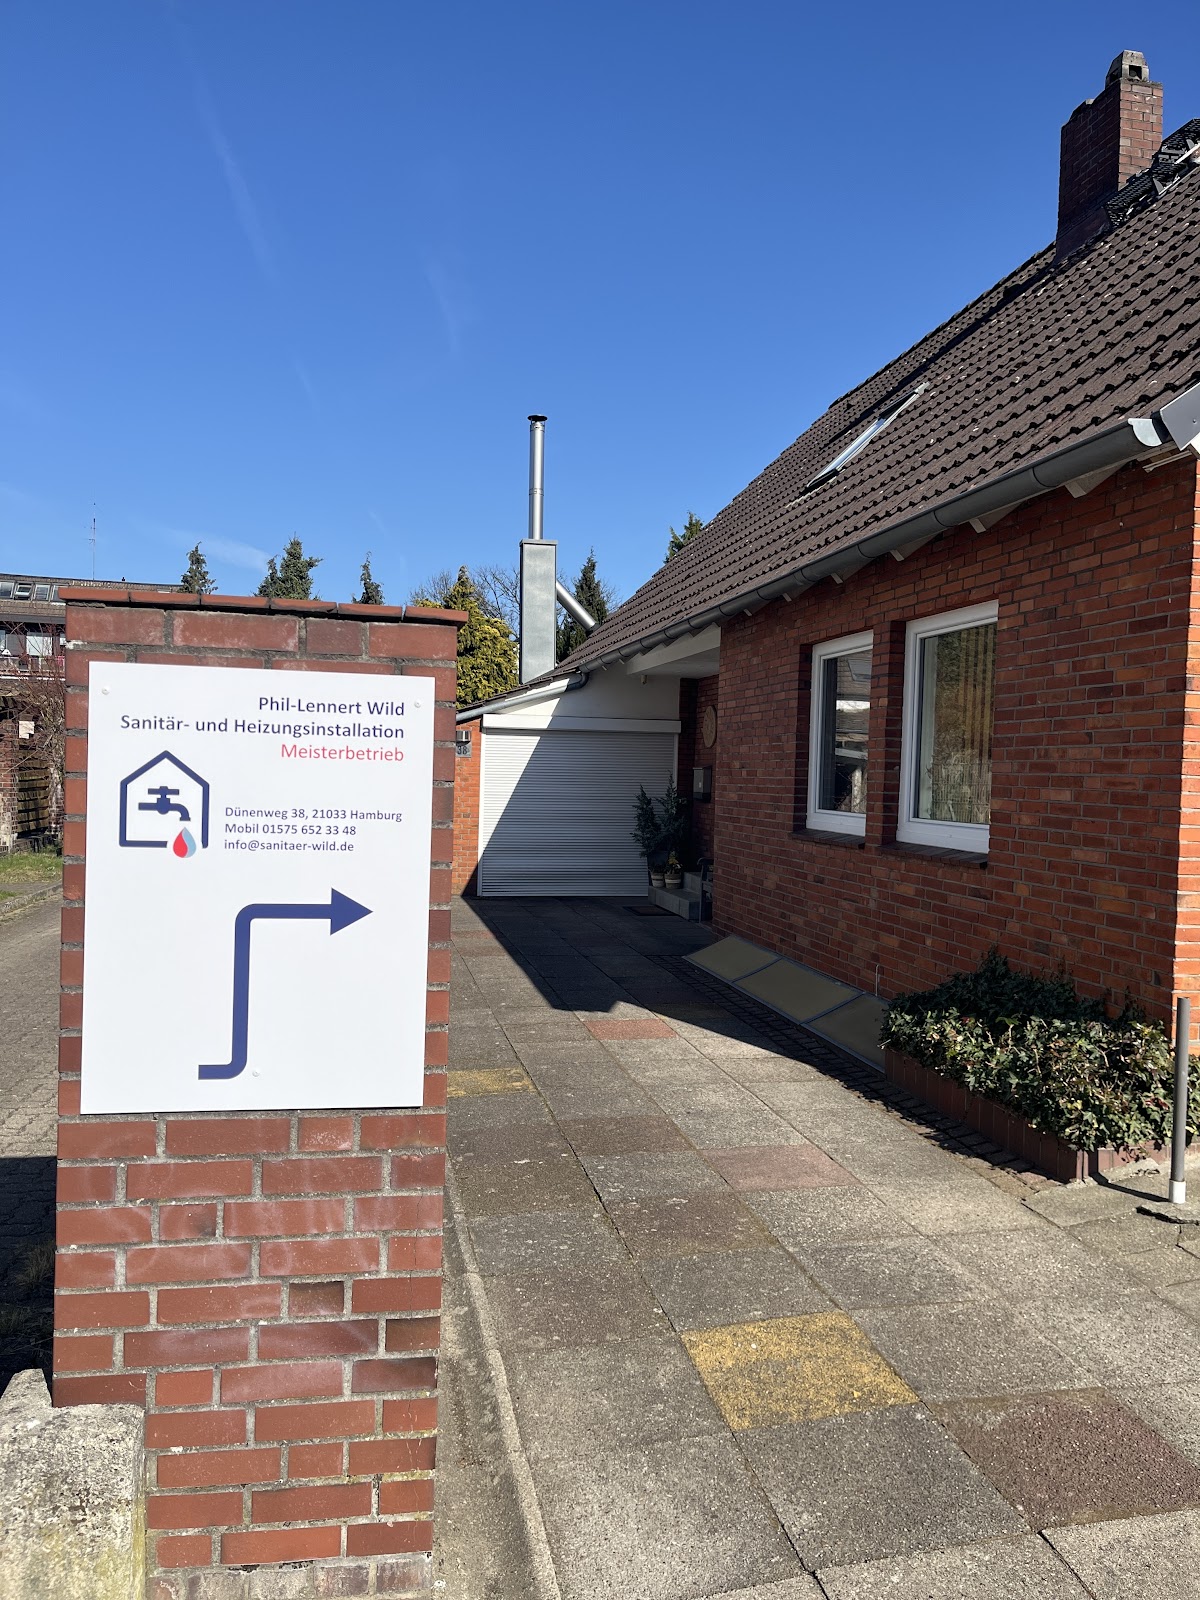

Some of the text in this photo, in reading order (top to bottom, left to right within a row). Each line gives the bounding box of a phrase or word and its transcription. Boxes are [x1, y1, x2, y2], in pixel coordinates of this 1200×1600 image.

[260, 696, 404, 716] Phil-Lennert Wild
[120, 714, 404, 738] Sanitär- und Heizungsinstallation
[282, 744, 404, 762] Meisterbetrieb
[226, 806, 402, 822] Dünenweg 38, 21033 Hamburg
[224, 824, 356, 836] Mobil 01575 652 33 48
[224, 840, 354, 852] info@sanitaer-wild.de
